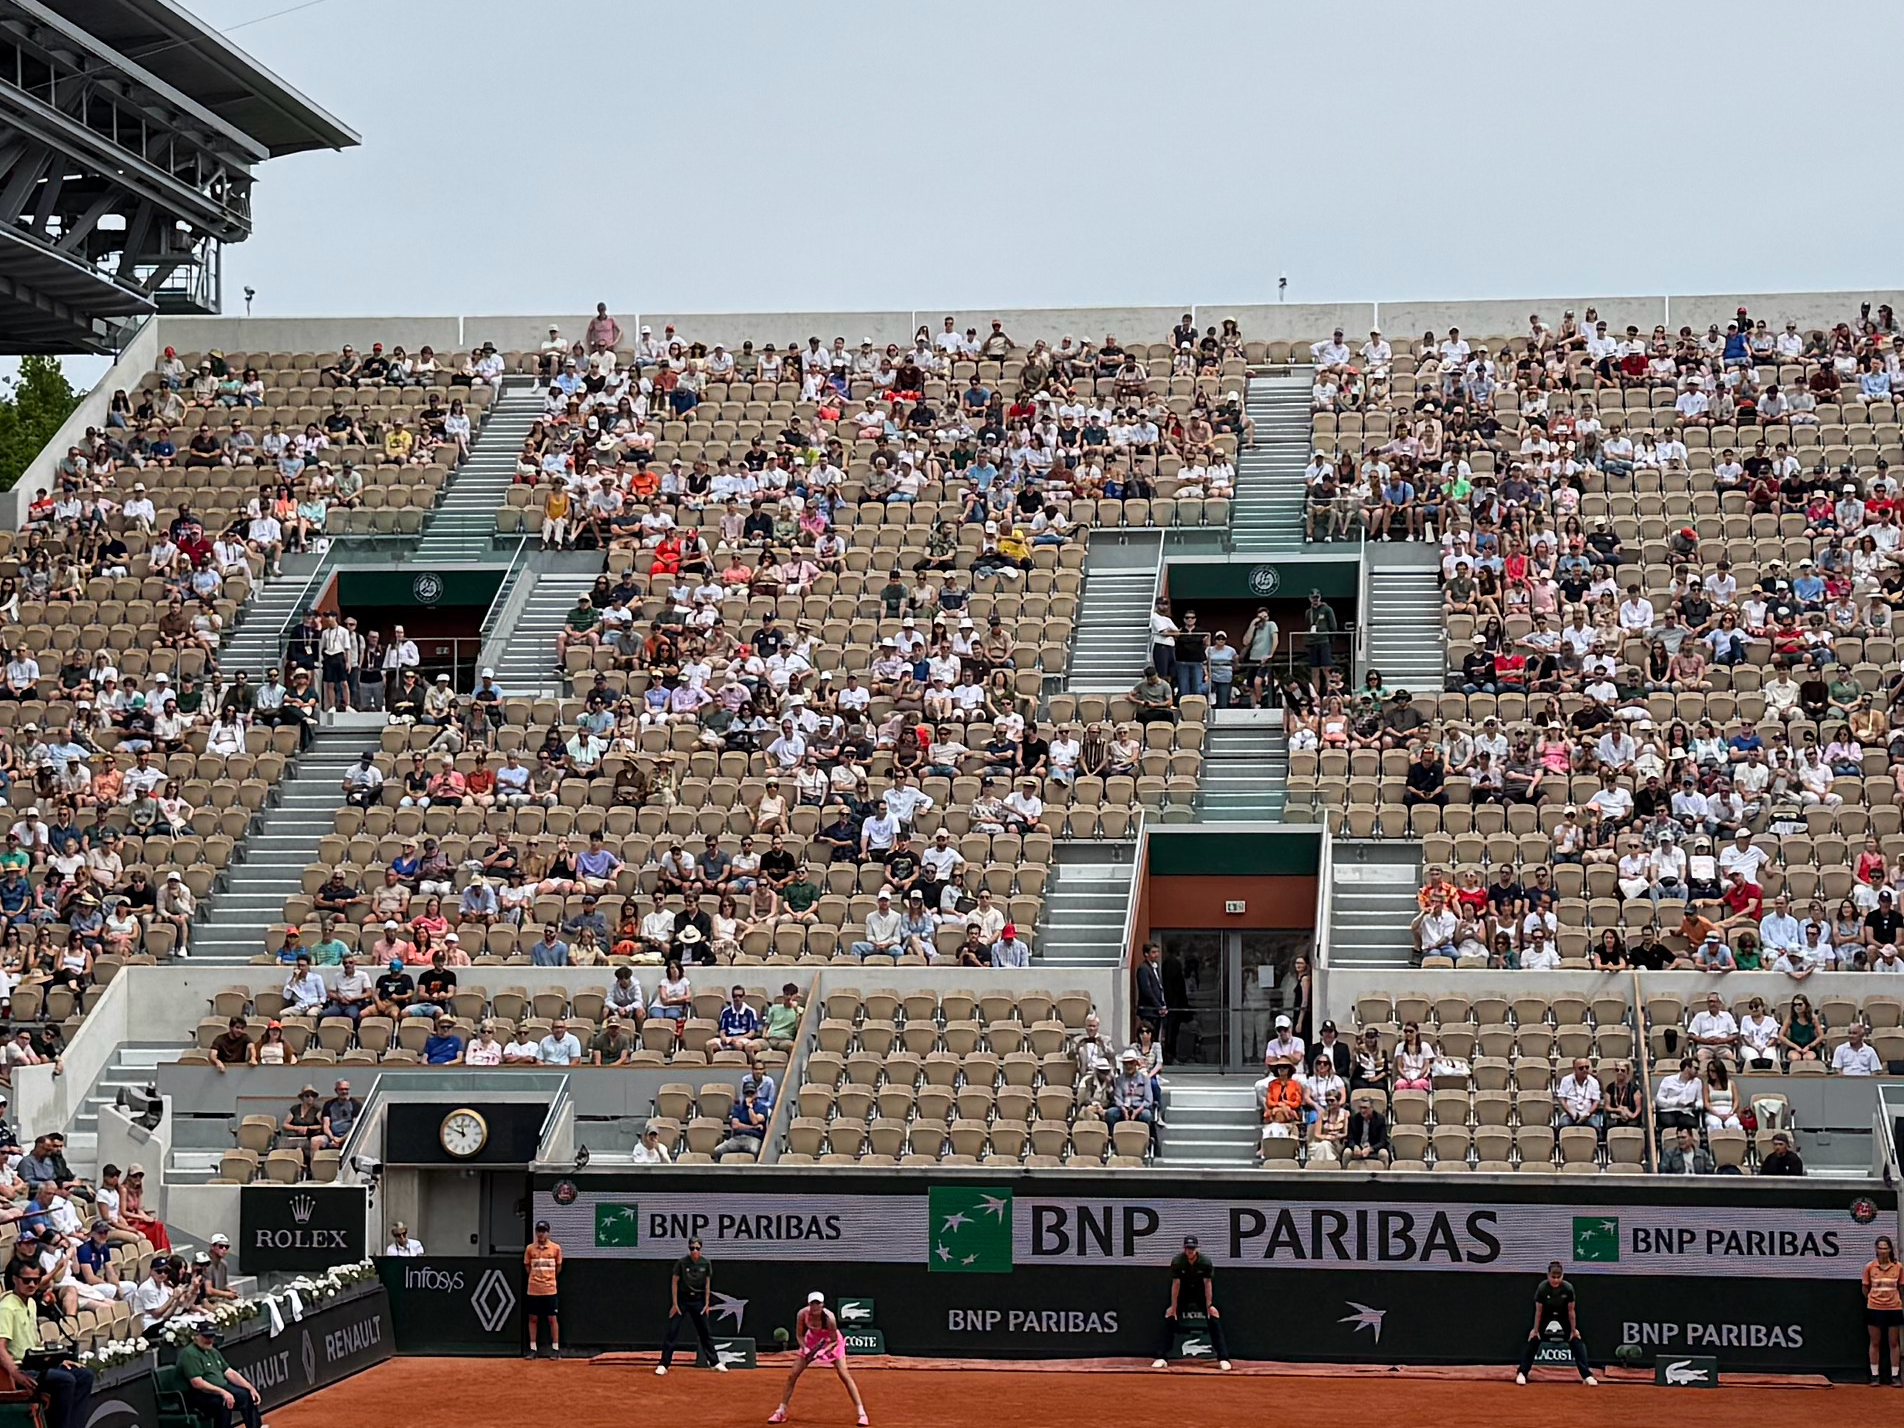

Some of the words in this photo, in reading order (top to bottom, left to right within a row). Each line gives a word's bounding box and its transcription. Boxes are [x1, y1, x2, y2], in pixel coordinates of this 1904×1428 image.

[255, 1229, 349, 1248] ROLEX
[649, 1213, 710, 1240] BNP
[718, 1214, 842, 1241] PARIBAS
[1030, 1204, 1159, 1258] BNP
[1228, 1207, 1502, 1264] PARIBAS
[1632, 1227, 1696, 1254] BNP
[1706, 1229, 1841, 1258] PARIBAS
[405, 1265, 465, 1294] Infosys
[947, 1309, 1001, 1332] BNP
[1008, 1310, 1119, 1334] PARIBAS
[1622, 1322, 1679, 1346] BNP
[1686, 1323, 1804, 1349] PARIBAS
[325, 1315, 381, 1363] RENAULT
